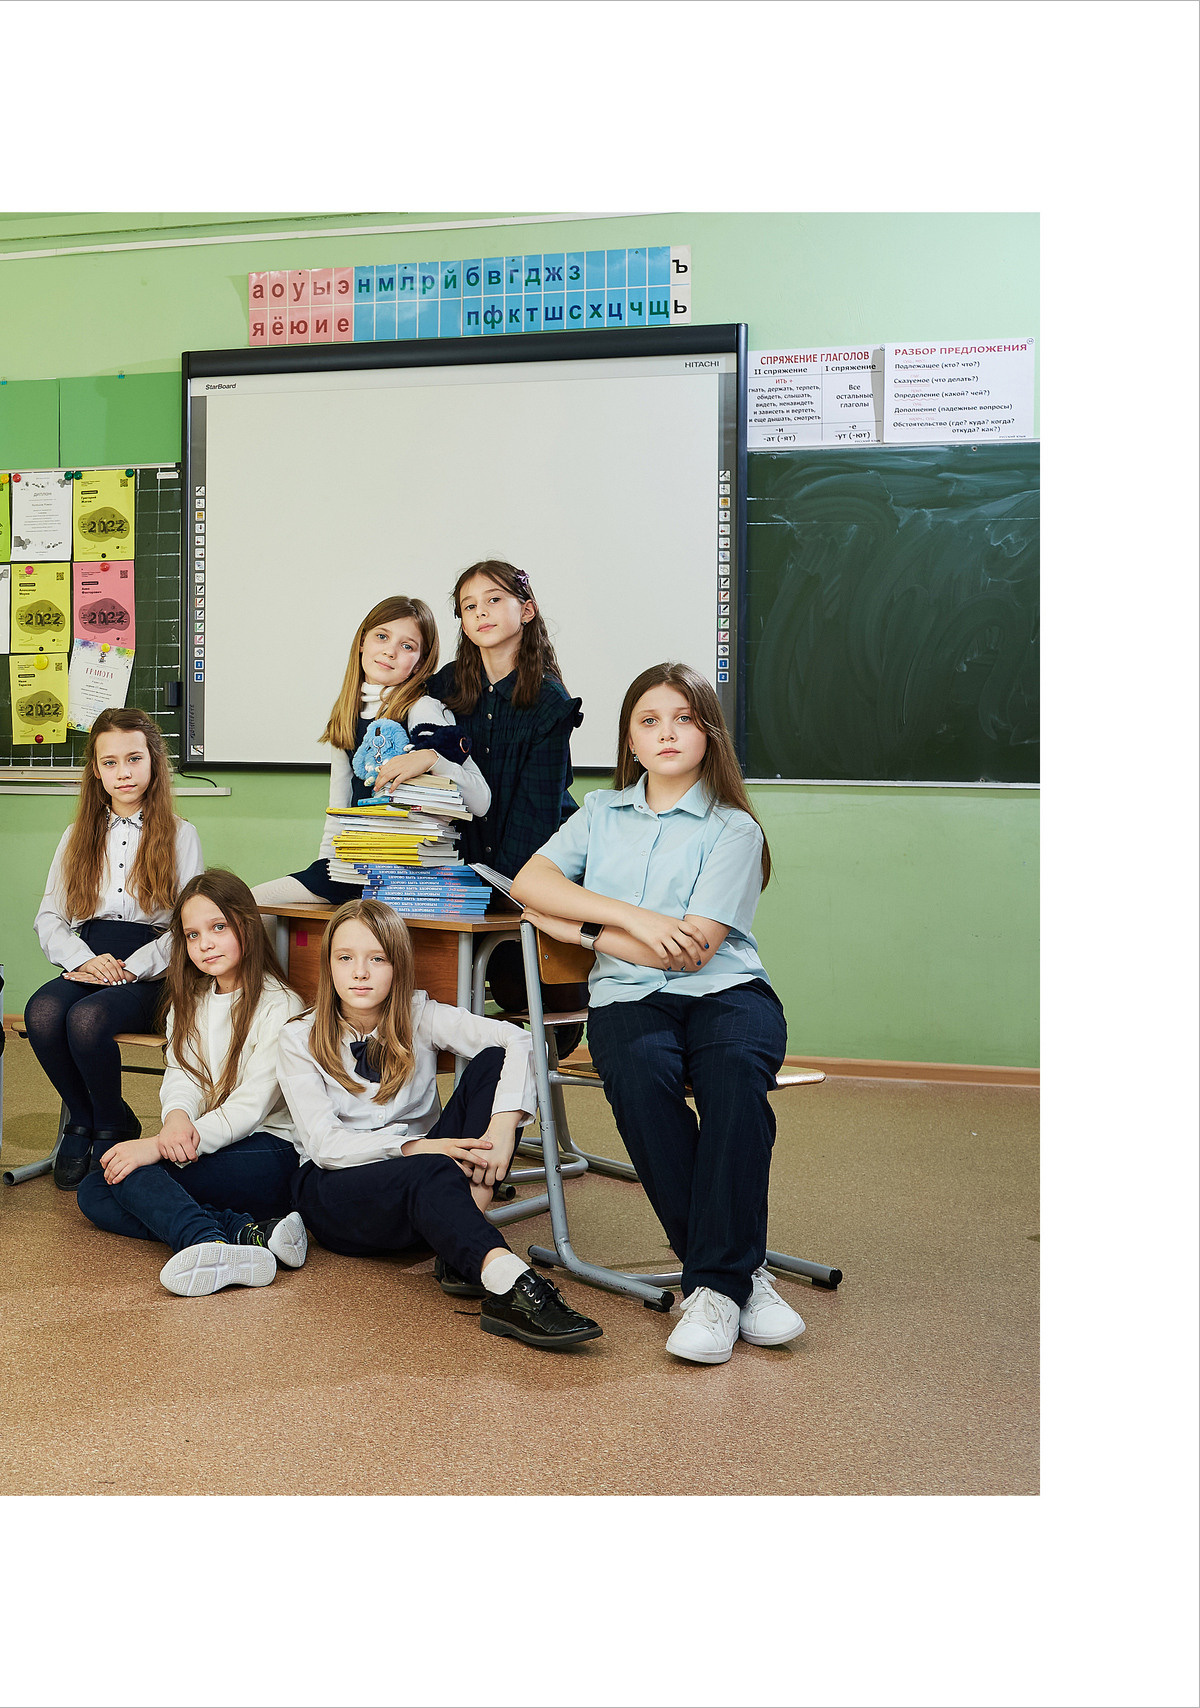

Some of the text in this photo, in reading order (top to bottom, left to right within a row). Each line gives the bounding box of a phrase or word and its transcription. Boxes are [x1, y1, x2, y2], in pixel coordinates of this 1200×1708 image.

[894, 344, 1026, 355] РАЗБОР ПРЕДЛОЖЕНИЯ
[760, 351, 869, 365] СПРЯЖЕНИЕ ГЛАГОЛОВ
[763, 367, 807, 375] спряжение
[831, 364, 876, 372] спряжение
[941, 390, 969, 398] (какой?
